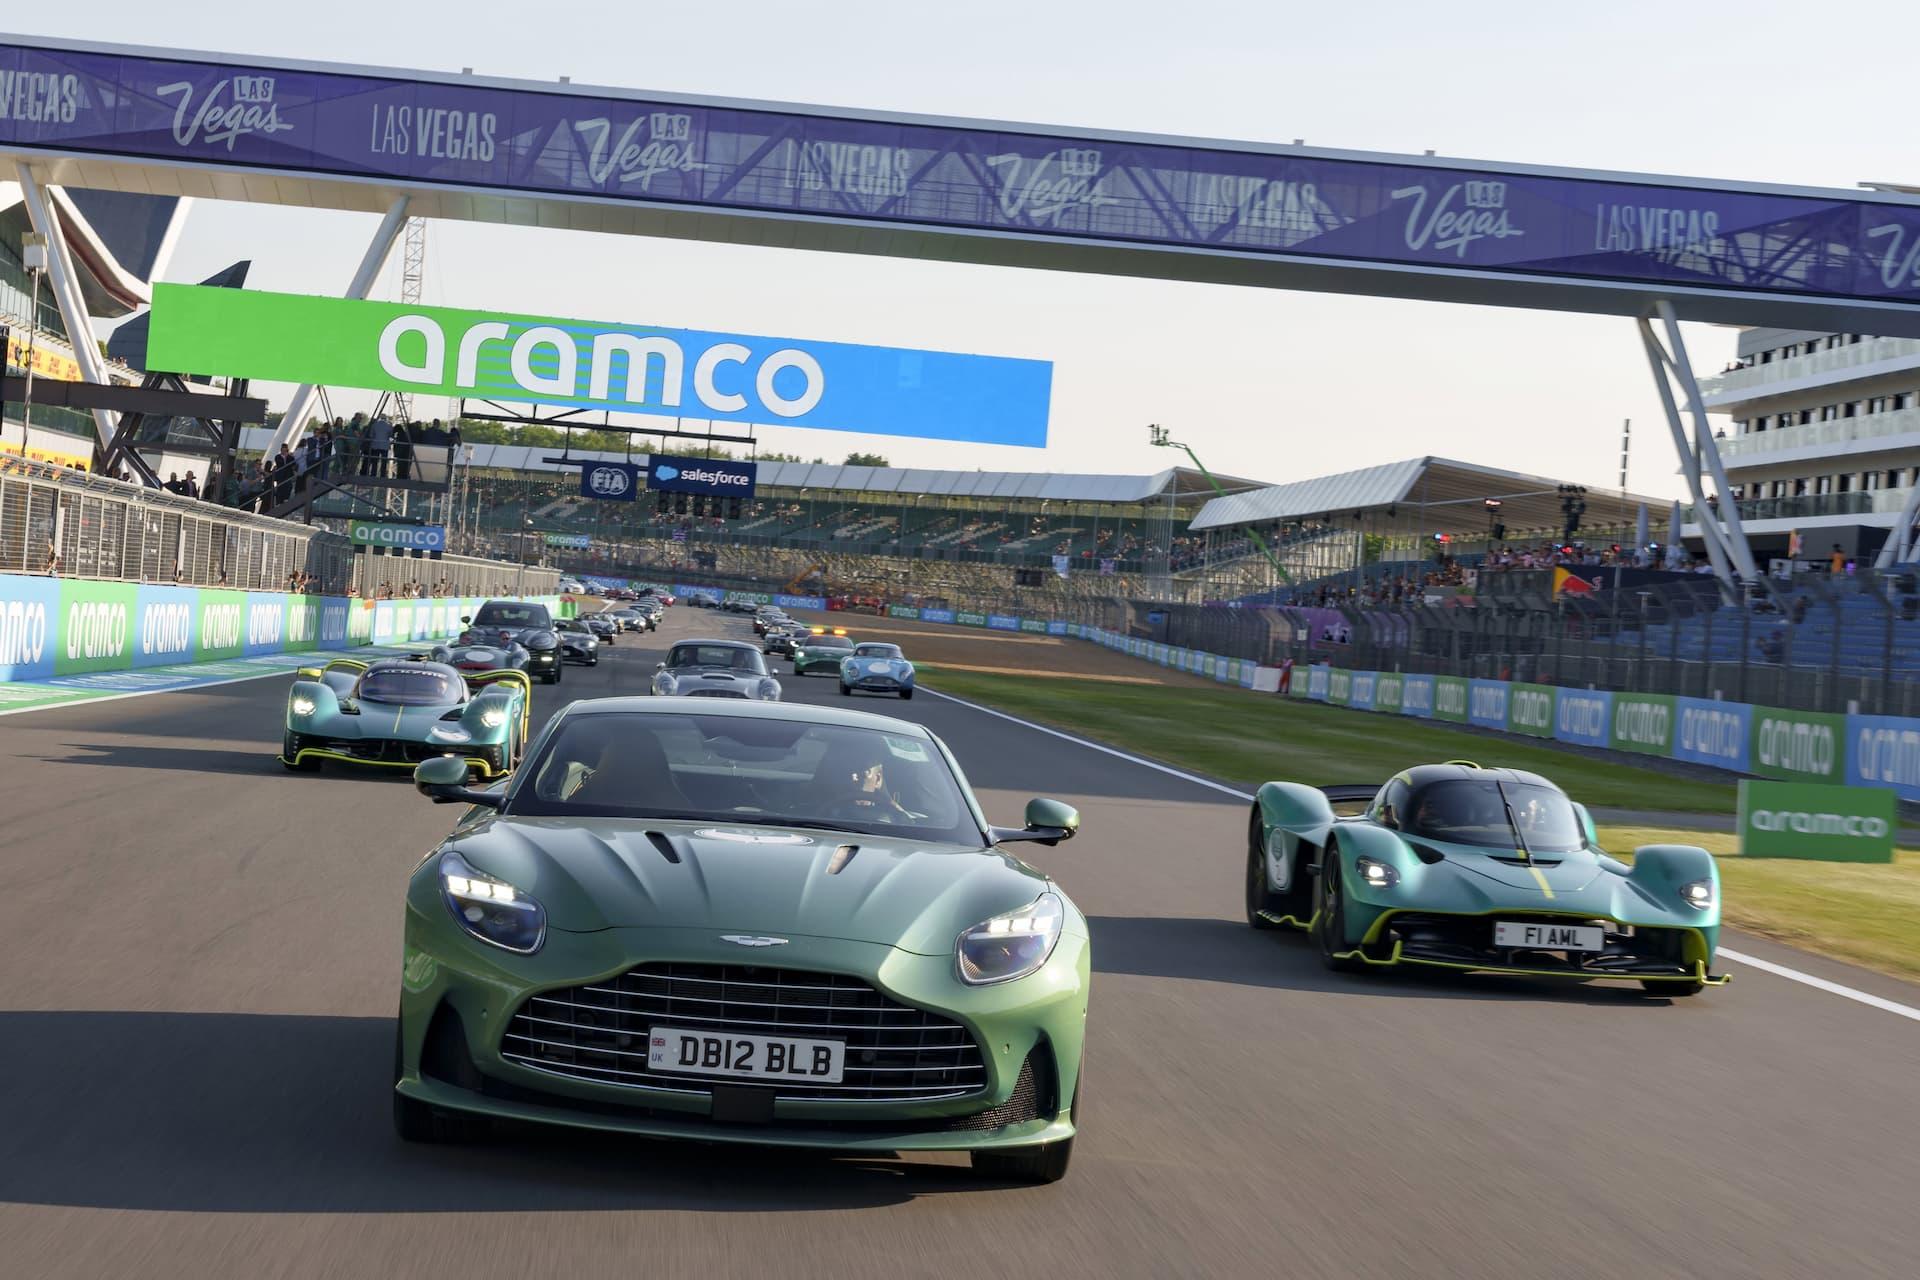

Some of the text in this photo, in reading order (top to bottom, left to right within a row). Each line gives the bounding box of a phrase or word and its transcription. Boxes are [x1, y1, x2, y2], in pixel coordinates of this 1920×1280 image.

[237, 78, 272, 100] LAS
[157, 79, 293, 152] Vegas
[371, 103, 496, 162] LAS VEGAS
[653, 113, 689, 139] LAS
[575, 115, 708, 191] Vegas
[784, 140, 909, 197] LAS VEGAS
[987, 152, 1121, 227] Vegas
[1236, 177, 1318, 232] VEGAS
[1392, 184, 1524, 257] Vegas
[1595, 203, 1719, 259] LAS VEGAS
[378, 314, 825, 418] aramco
[681, 469, 749, 486] salesforce
[355, 526, 440, 545] aramco
[548, 535, 588, 546] aramco
[67, 601, 126, 659] aramco
[143, 603, 189, 654] aramco
[202, 604, 241, 649] aramco
[250, 604, 281, 645] aramco
[1681, 708, 1742, 759] aramco
[1759, 718, 1834, 775] aramco
[1752, 810, 1888, 838] aramco
[1547, 928, 1583, 946] AML
[652, 1053, 663, 1063] UK
[678, 1035, 831, 1076] DB12 BLB
